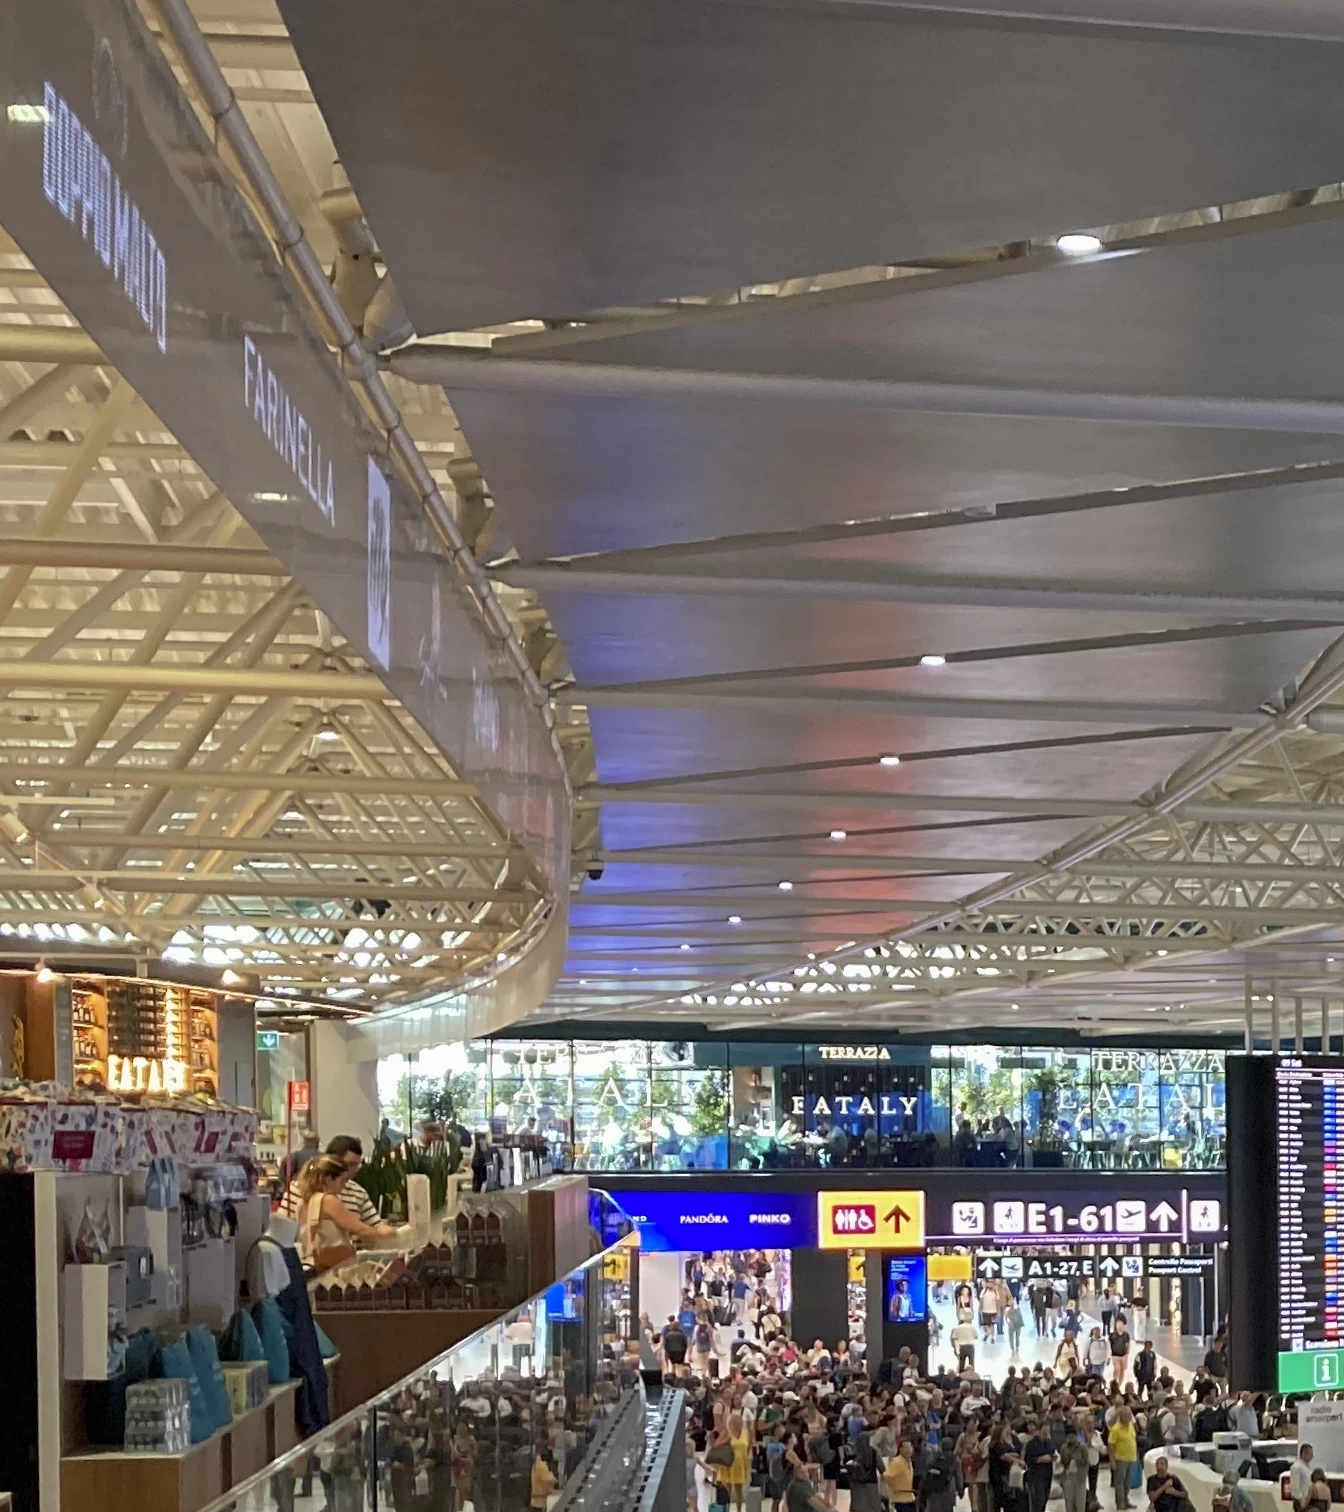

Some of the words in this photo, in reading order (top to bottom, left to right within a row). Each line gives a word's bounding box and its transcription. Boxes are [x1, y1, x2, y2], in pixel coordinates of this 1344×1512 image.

[243, 333, 336, 529] FARINELLA
[818, 1046, 891, 1059] TERRAZZA
[1093, 1051, 1225, 1073] TERRAZZA
[791, 1095, 918, 1115] EATALY
[1057, 1082, 1225, 1110] EATAL
[749, 1213, 792, 1224] PINKO
[1027, 1202, 1115, 1233] E1-61
[1083, 1260, 1093, 1275] E
[1310, 1405, 1331, 1413] radio
